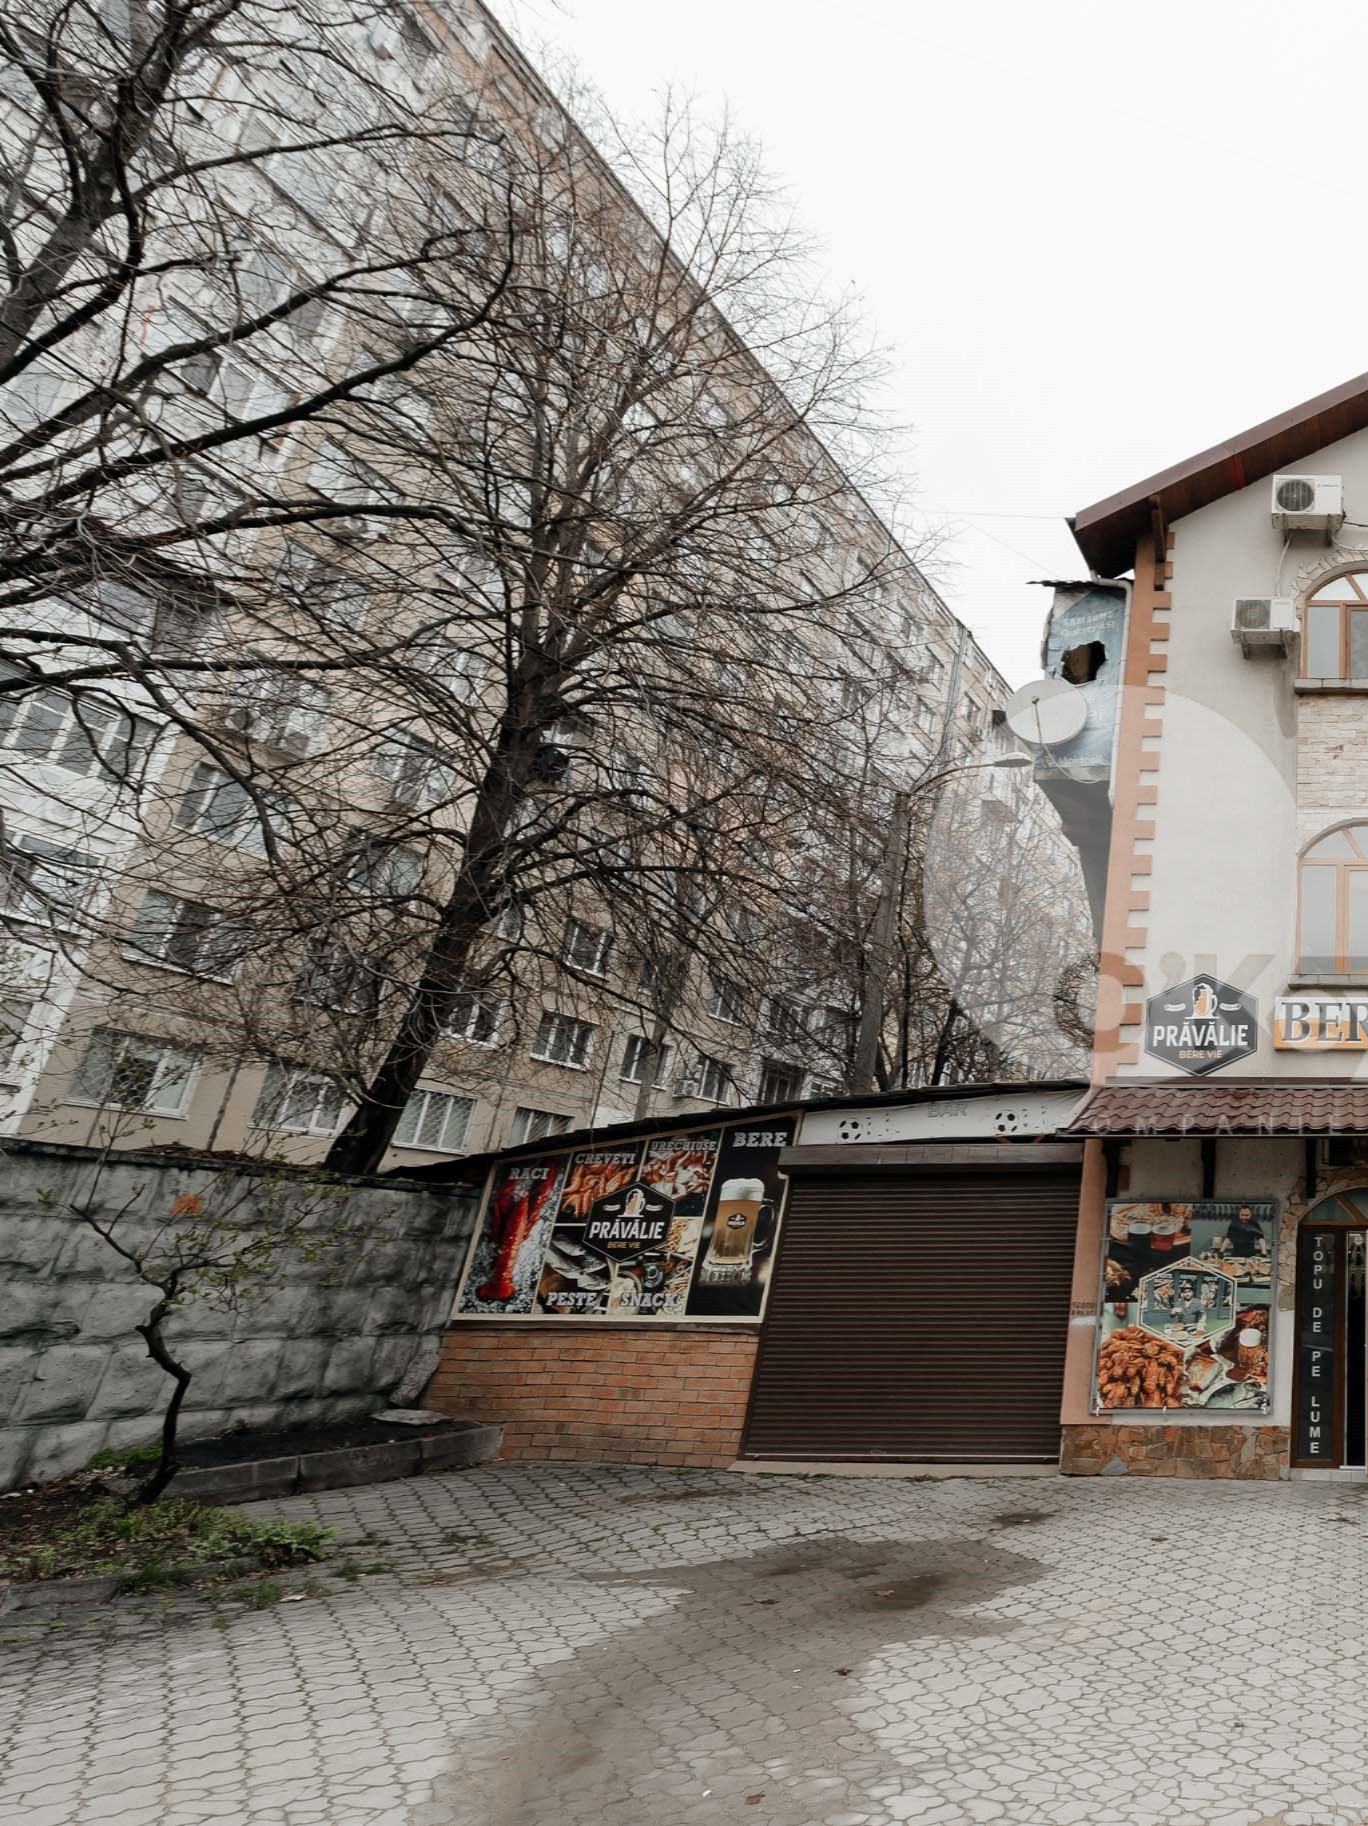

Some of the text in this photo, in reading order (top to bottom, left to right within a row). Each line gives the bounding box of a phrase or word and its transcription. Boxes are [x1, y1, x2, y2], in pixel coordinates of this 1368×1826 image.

[1152, 1021, 1248, 1047] PRĂVĂLIE
[1179, 1050, 1222, 1059] BERE VIE
[732, 1131, 788, 1148] BERE
[508, 1167, 551, 1181] RACI
[588, 1218, 665, 1239] PRĂVĂLIE
[620, 1291, 678, 1308] SNACK
